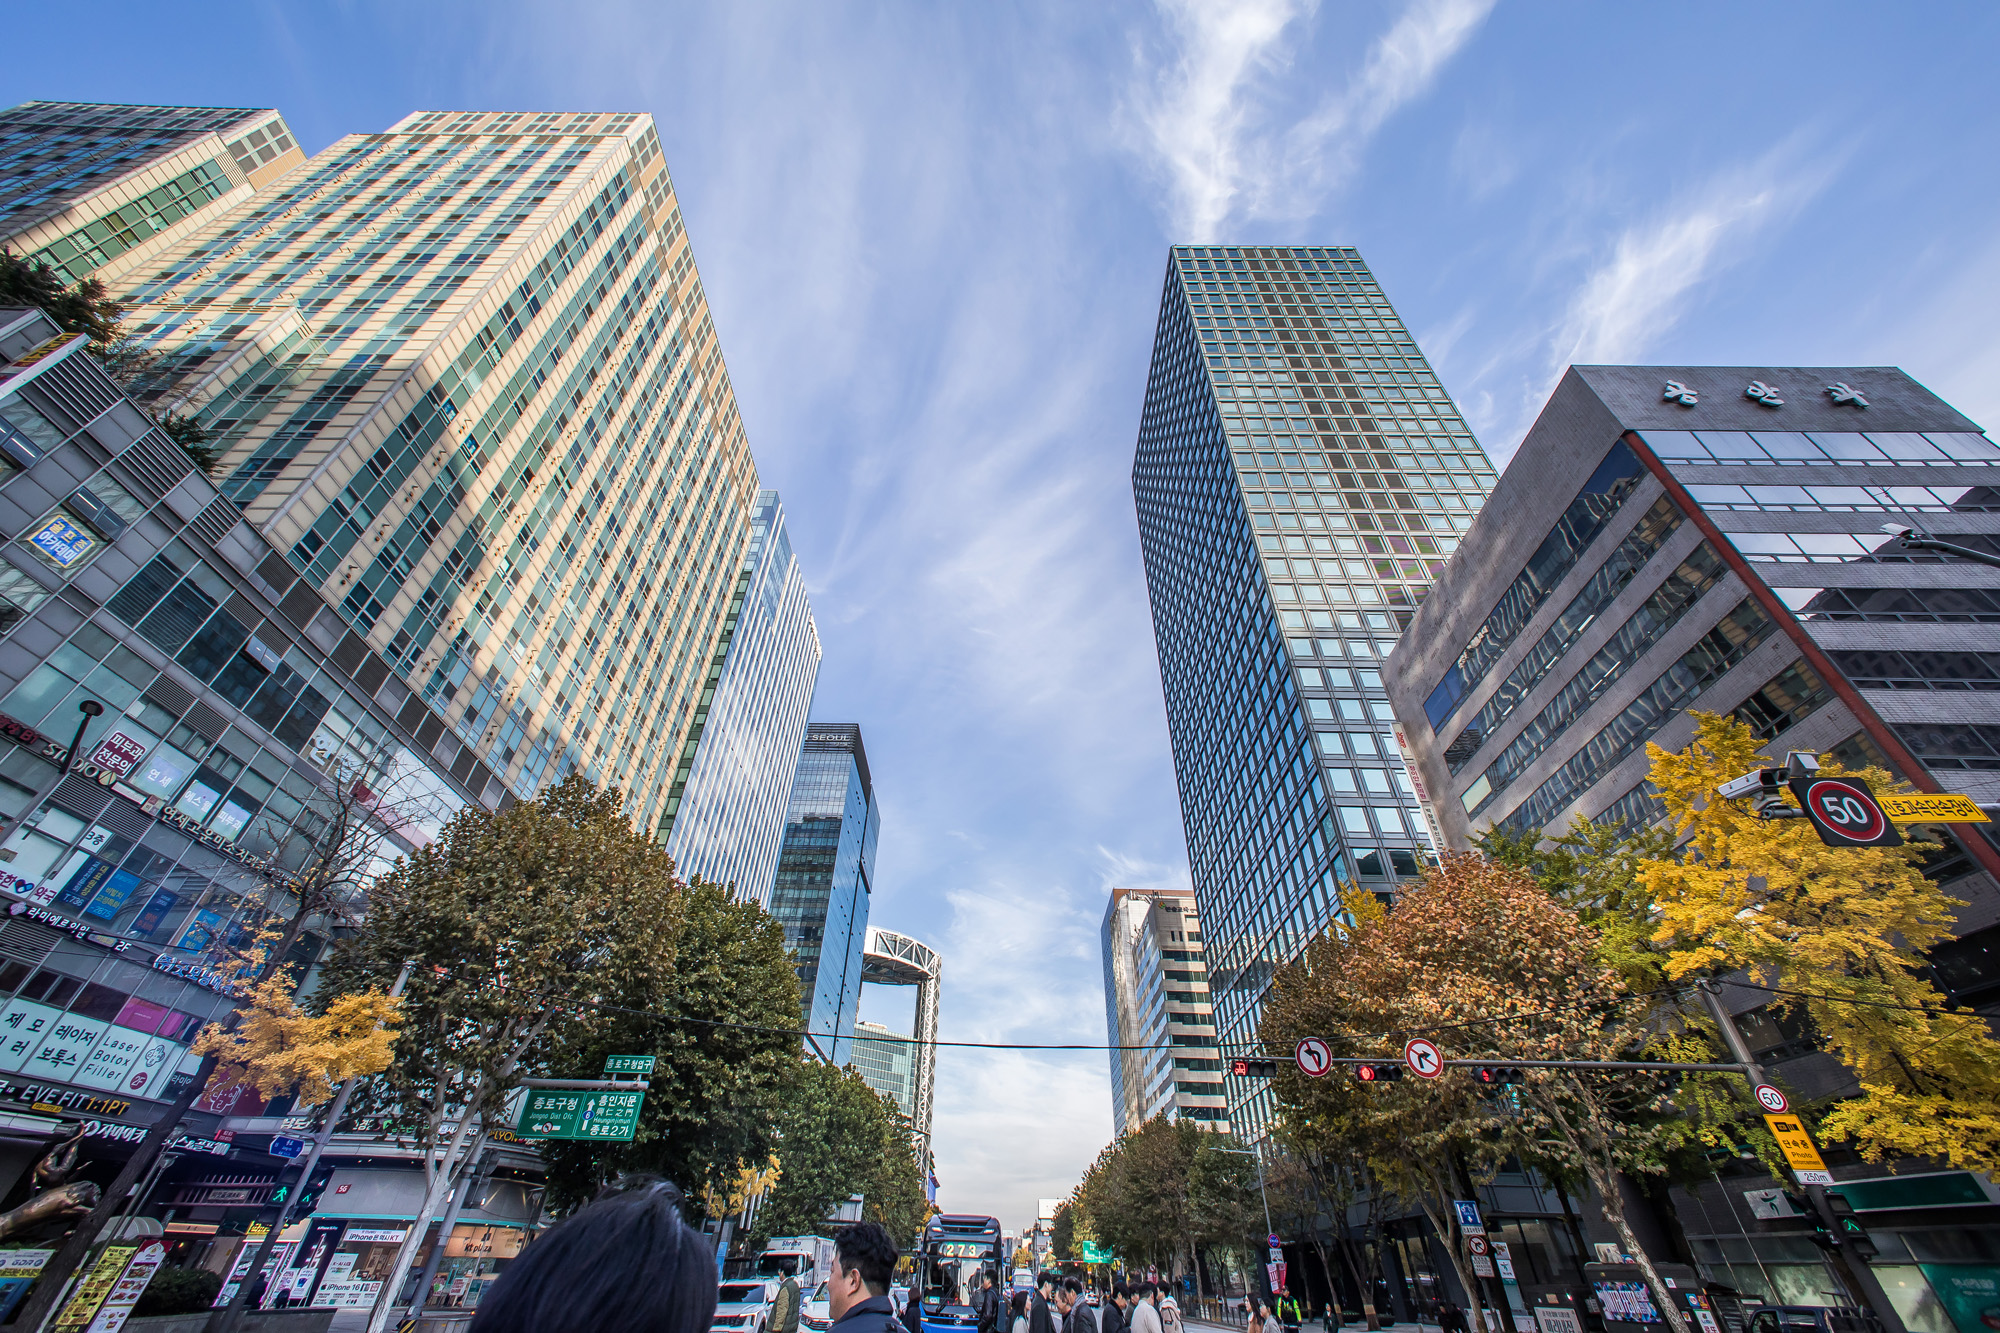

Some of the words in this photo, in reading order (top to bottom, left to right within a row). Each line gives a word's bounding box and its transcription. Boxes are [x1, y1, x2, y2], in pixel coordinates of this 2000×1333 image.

[38, 531, 78, 562] 아카데미
[110, 734, 144, 760] 피부과
[98, 748, 133, 774] 전문의
[147, 766, 174, 788] 연세
[1822, 796, 1868, 824] 50
[1882, 799, 1981, 817] 신호과속단속장비
[217, 810, 243, 831] 피부과
[85, 831, 105, 846] 3층
[34, 886, 57, 904] 약국
[115, 941, 132, 953] 2F
[55, 1025, 98, 1046] 레이저
[103, 1036, 140, 1053] Laser
[36, 1047, 77, 1068] 보톡스
[94, 1050, 131, 1066] Botox
[607, 1058, 652, 1070] 종로구청입구
[83, 1064, 122, 1080] Filler
[132, 1075, 147, 1087] 2F
[20, 1085, 57, 1104] EVE
[57, 1091, 90, 1108] FIT
[534, 1097, 579, 1111] 종로구청
[598, 1095, 637, 1108] 흥인지문
[1761, 1092, 1781, 1107] 50
[529, 1113, 548, 1121] Jongno
[550, 1112, 561, 1120] Dist
[585, 1112, 592, 1120] 6
[590, 1125, 629, 1137] 종로2가
[1782, 1139, 1809, 1149] 단속중
[1803, 1173, 1828, 1182] 250m
[338, 1184, 348, 1193] 5G
[946, 1242, 977, 1257] 273
[327, 1283, 351, 1291] iPhone
